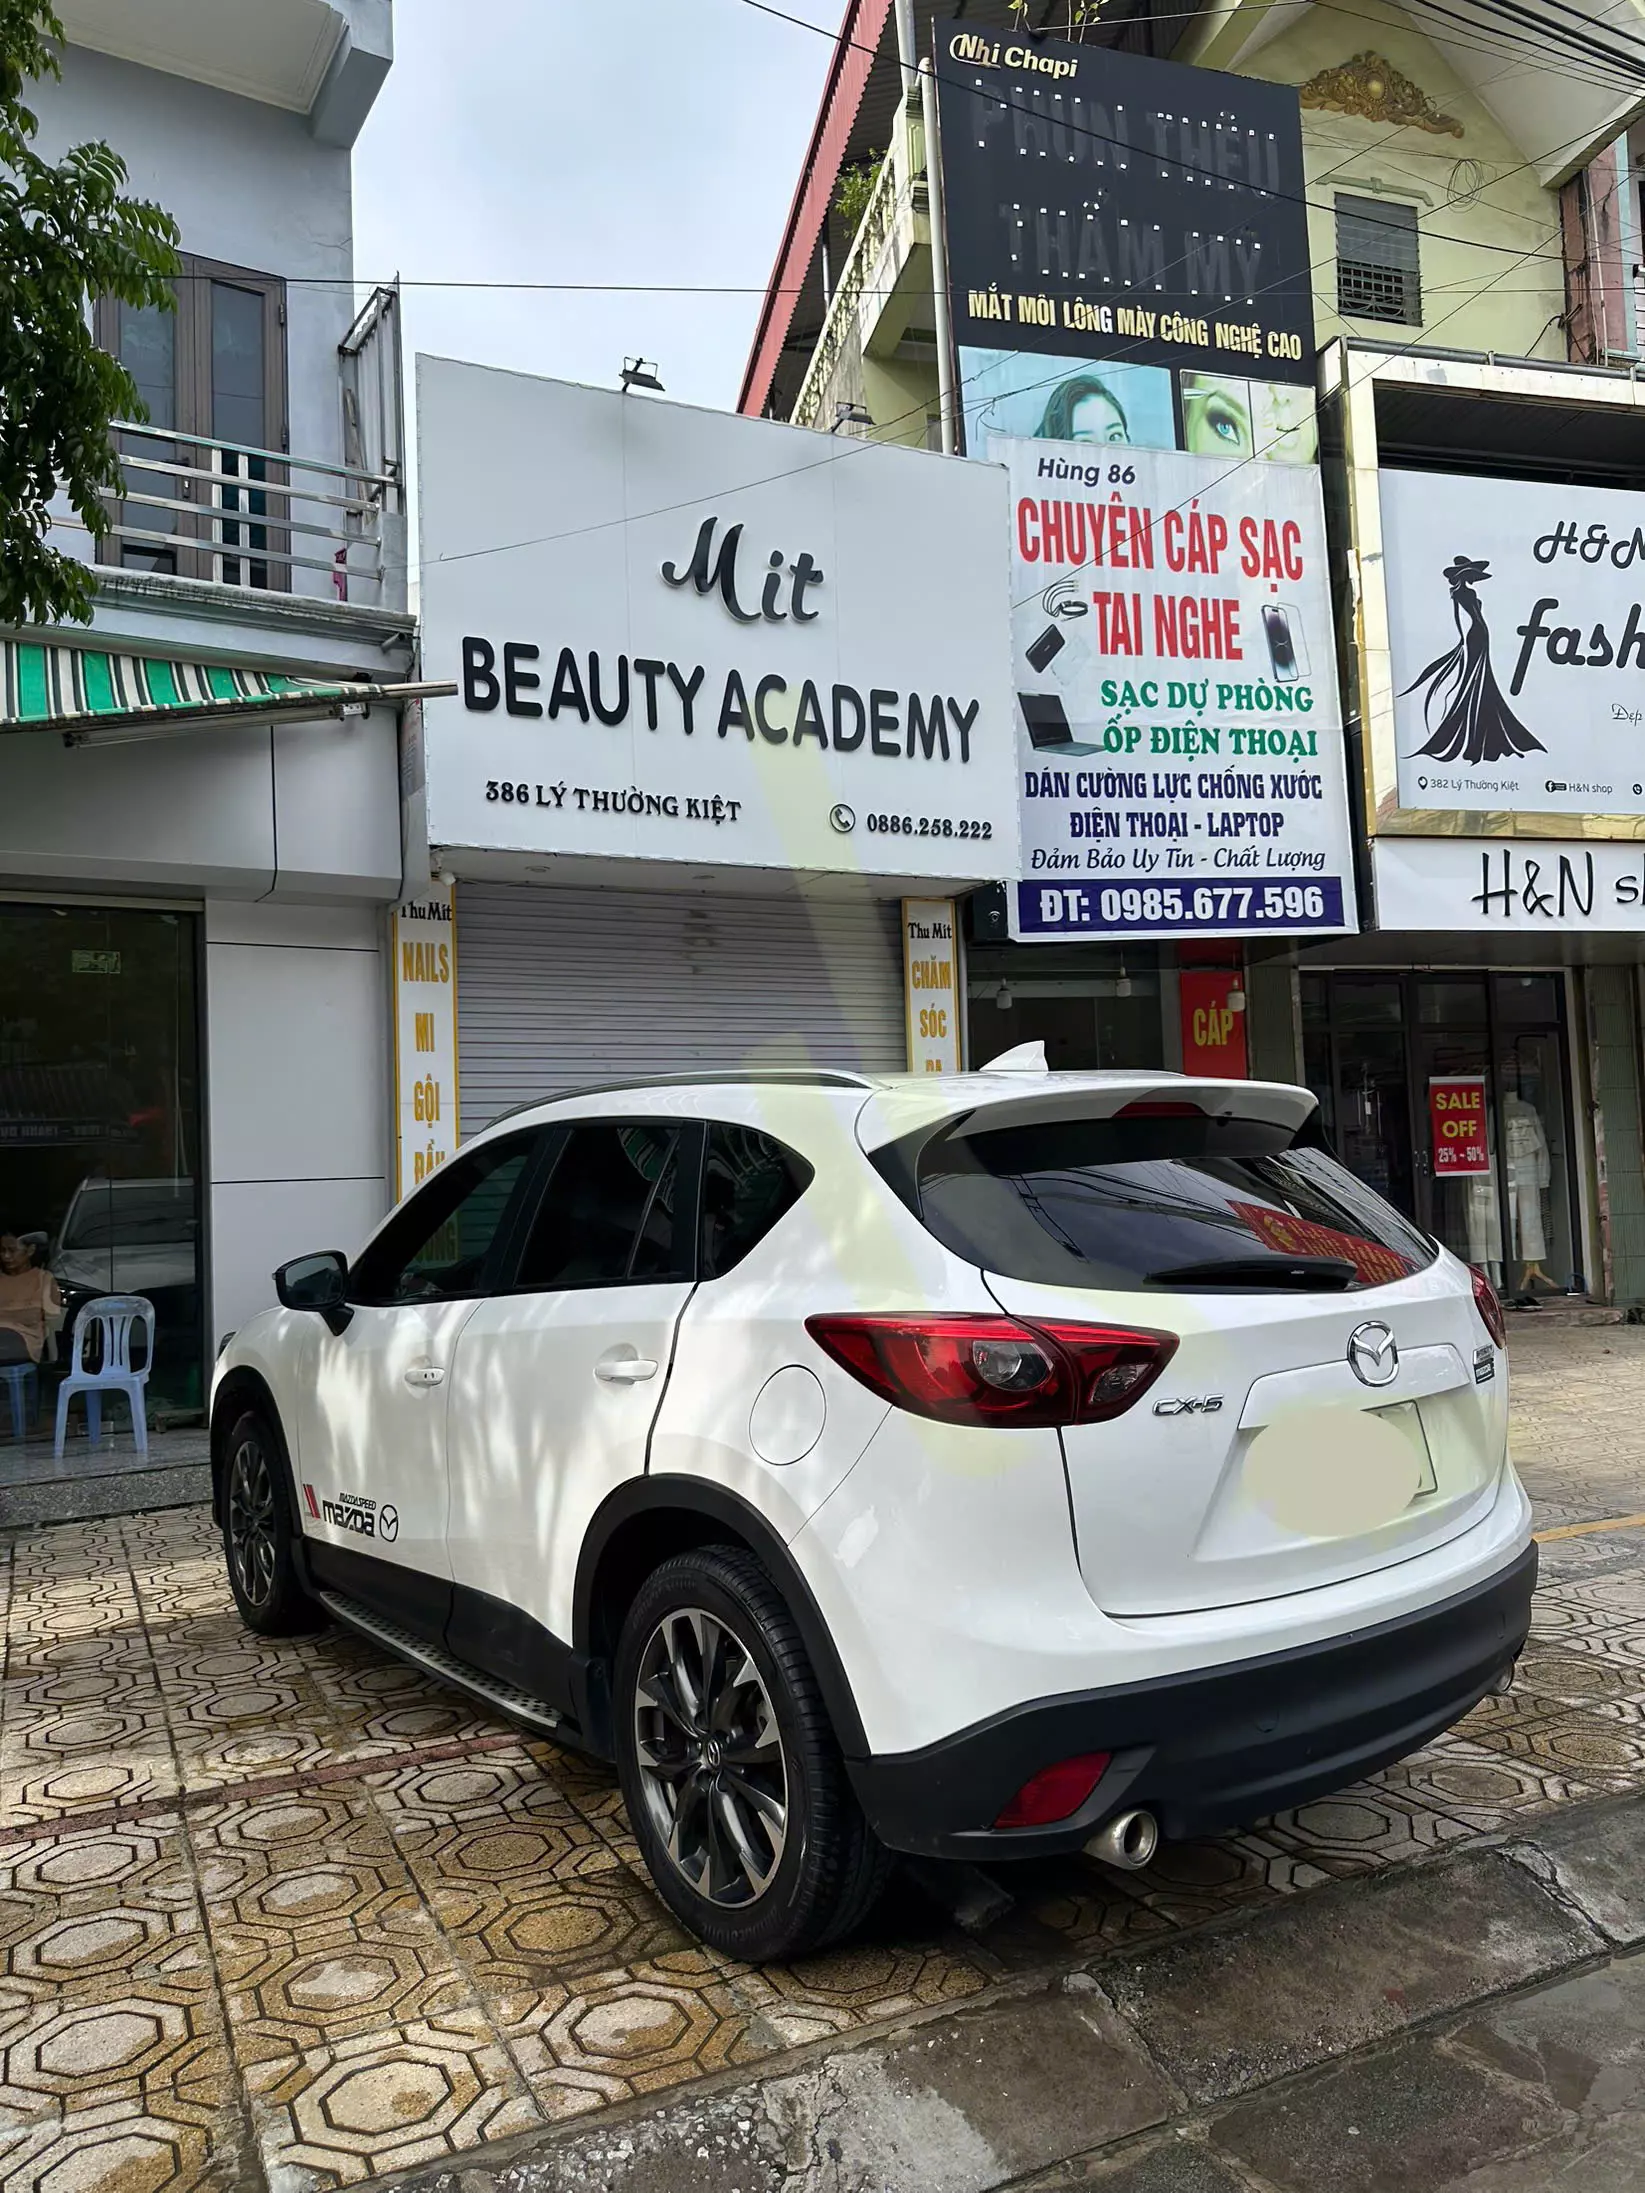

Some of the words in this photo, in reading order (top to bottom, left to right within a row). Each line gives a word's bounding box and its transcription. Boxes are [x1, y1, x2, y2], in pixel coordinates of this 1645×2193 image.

[953, 33, 1001, 66] Nhi
[1004, 46, 1079, 80] Chapi
[968, 282, 1012, 321] MẮT
[1018, 293, 1056, 327] MÔI
[1063, 296, 1113, 334] LÔNG
[1116, 304, 1156, 339] MÀY
[1159, 311, 1209, 347] CÔNG
[1215, 322, 1262, 359] NGHỆ
[1267, 331, 1303, 361] CAO
[1037, 457, 1100, 487] Hùng
[1107, 464, 1136, 485] 86
[1017, 491, 1154, 569] CHUYÊN
[1164, 498, 1228, 575] CÁP
[1239, 516, 1303, 593] SẠC
[659, 515, 825, 624] Mit
[1093, 591, 1143, 657] TAI
[1153, 594, 1243, 661] NGHE
[461, 635, 705, 736] BEAUTY
[717, 668, 980, 764] ACADEMY
[1101, 679, 1158, 715] SẠC
[1167, 678, 1209, 717] DỰ
[1216, 677, 1314, 712] PHÒNG
[1103, 713, 1142, 753] ỐP
[1150, 719, 1220, 762] ĐIỆN
[1228, 729, 1318, 764] THOẠI
[485, 780, 530, 804] 386
[536, 781, 567, 808] LÝ
[573, 785, 679, 817] THƯỜNG
[686, 794, 742, 825] KIỆT
[1025, 766, 1070, 799] DÁN
[1076, 767, 1147, 799] CƯỜNG
[1153, 771, 1192, 803] LỰC
[1199, 764, 1265, 800] CHỐNG
[1270, 769, 1323, 800] XƯỚC
[1430, 778, 1449, 789] 382
[1451, 778, 1462, 791] Lý
[1465, 779, 1499, 792] Thường
[1501, 780, 1520, 793] Kiệt
[1568, 782, 1591, 794] H&N
[1591, 783, 1613, 796] shop
[866, 812, 993, 841] 0886.258.222
[1070, 806, 1120, 843] ĐIỆN
[1126, 812, 1188, 843] THOẠI
[1207, 812, 1285, 837] LAPTOP
[1031, 848, 1081, 870] Đảm
[1086, 848, 1125, 869] Bảo
[1132, 850, 1159, 872] Uy
[1213, 845, 1261, 868] Chất
[1266, 847, 1326, 872] Lượng
[1471, 848, 1596, 919] H&N
[1040, 889, 1090, 922] ĐT:
[1100, 886, 1324, 921] 0985.677.596
[907, 922, 930, 939] Thu
[403, 941, 450, 984] NAILS
[911, 955, 952, 990] CHĂM
[415, 1012, 435, 1053] MI
[919, 1003, 947, 1039] SÓC
[1193, 1000, 1234, 1047] CÁP
[413, 1072, 441, 1129] GỘI
[1435, 1092, 1480, 1110] SALE
[1441, 1120, 1477, 1138] OFF
[1438, 1147, 1457, 1163] 25%
[1466, 1146, 1484, 1162] 50%
[1151, 1393, 1225, 1417] CX-5
[322, 1500, 376, 1538] mazda
